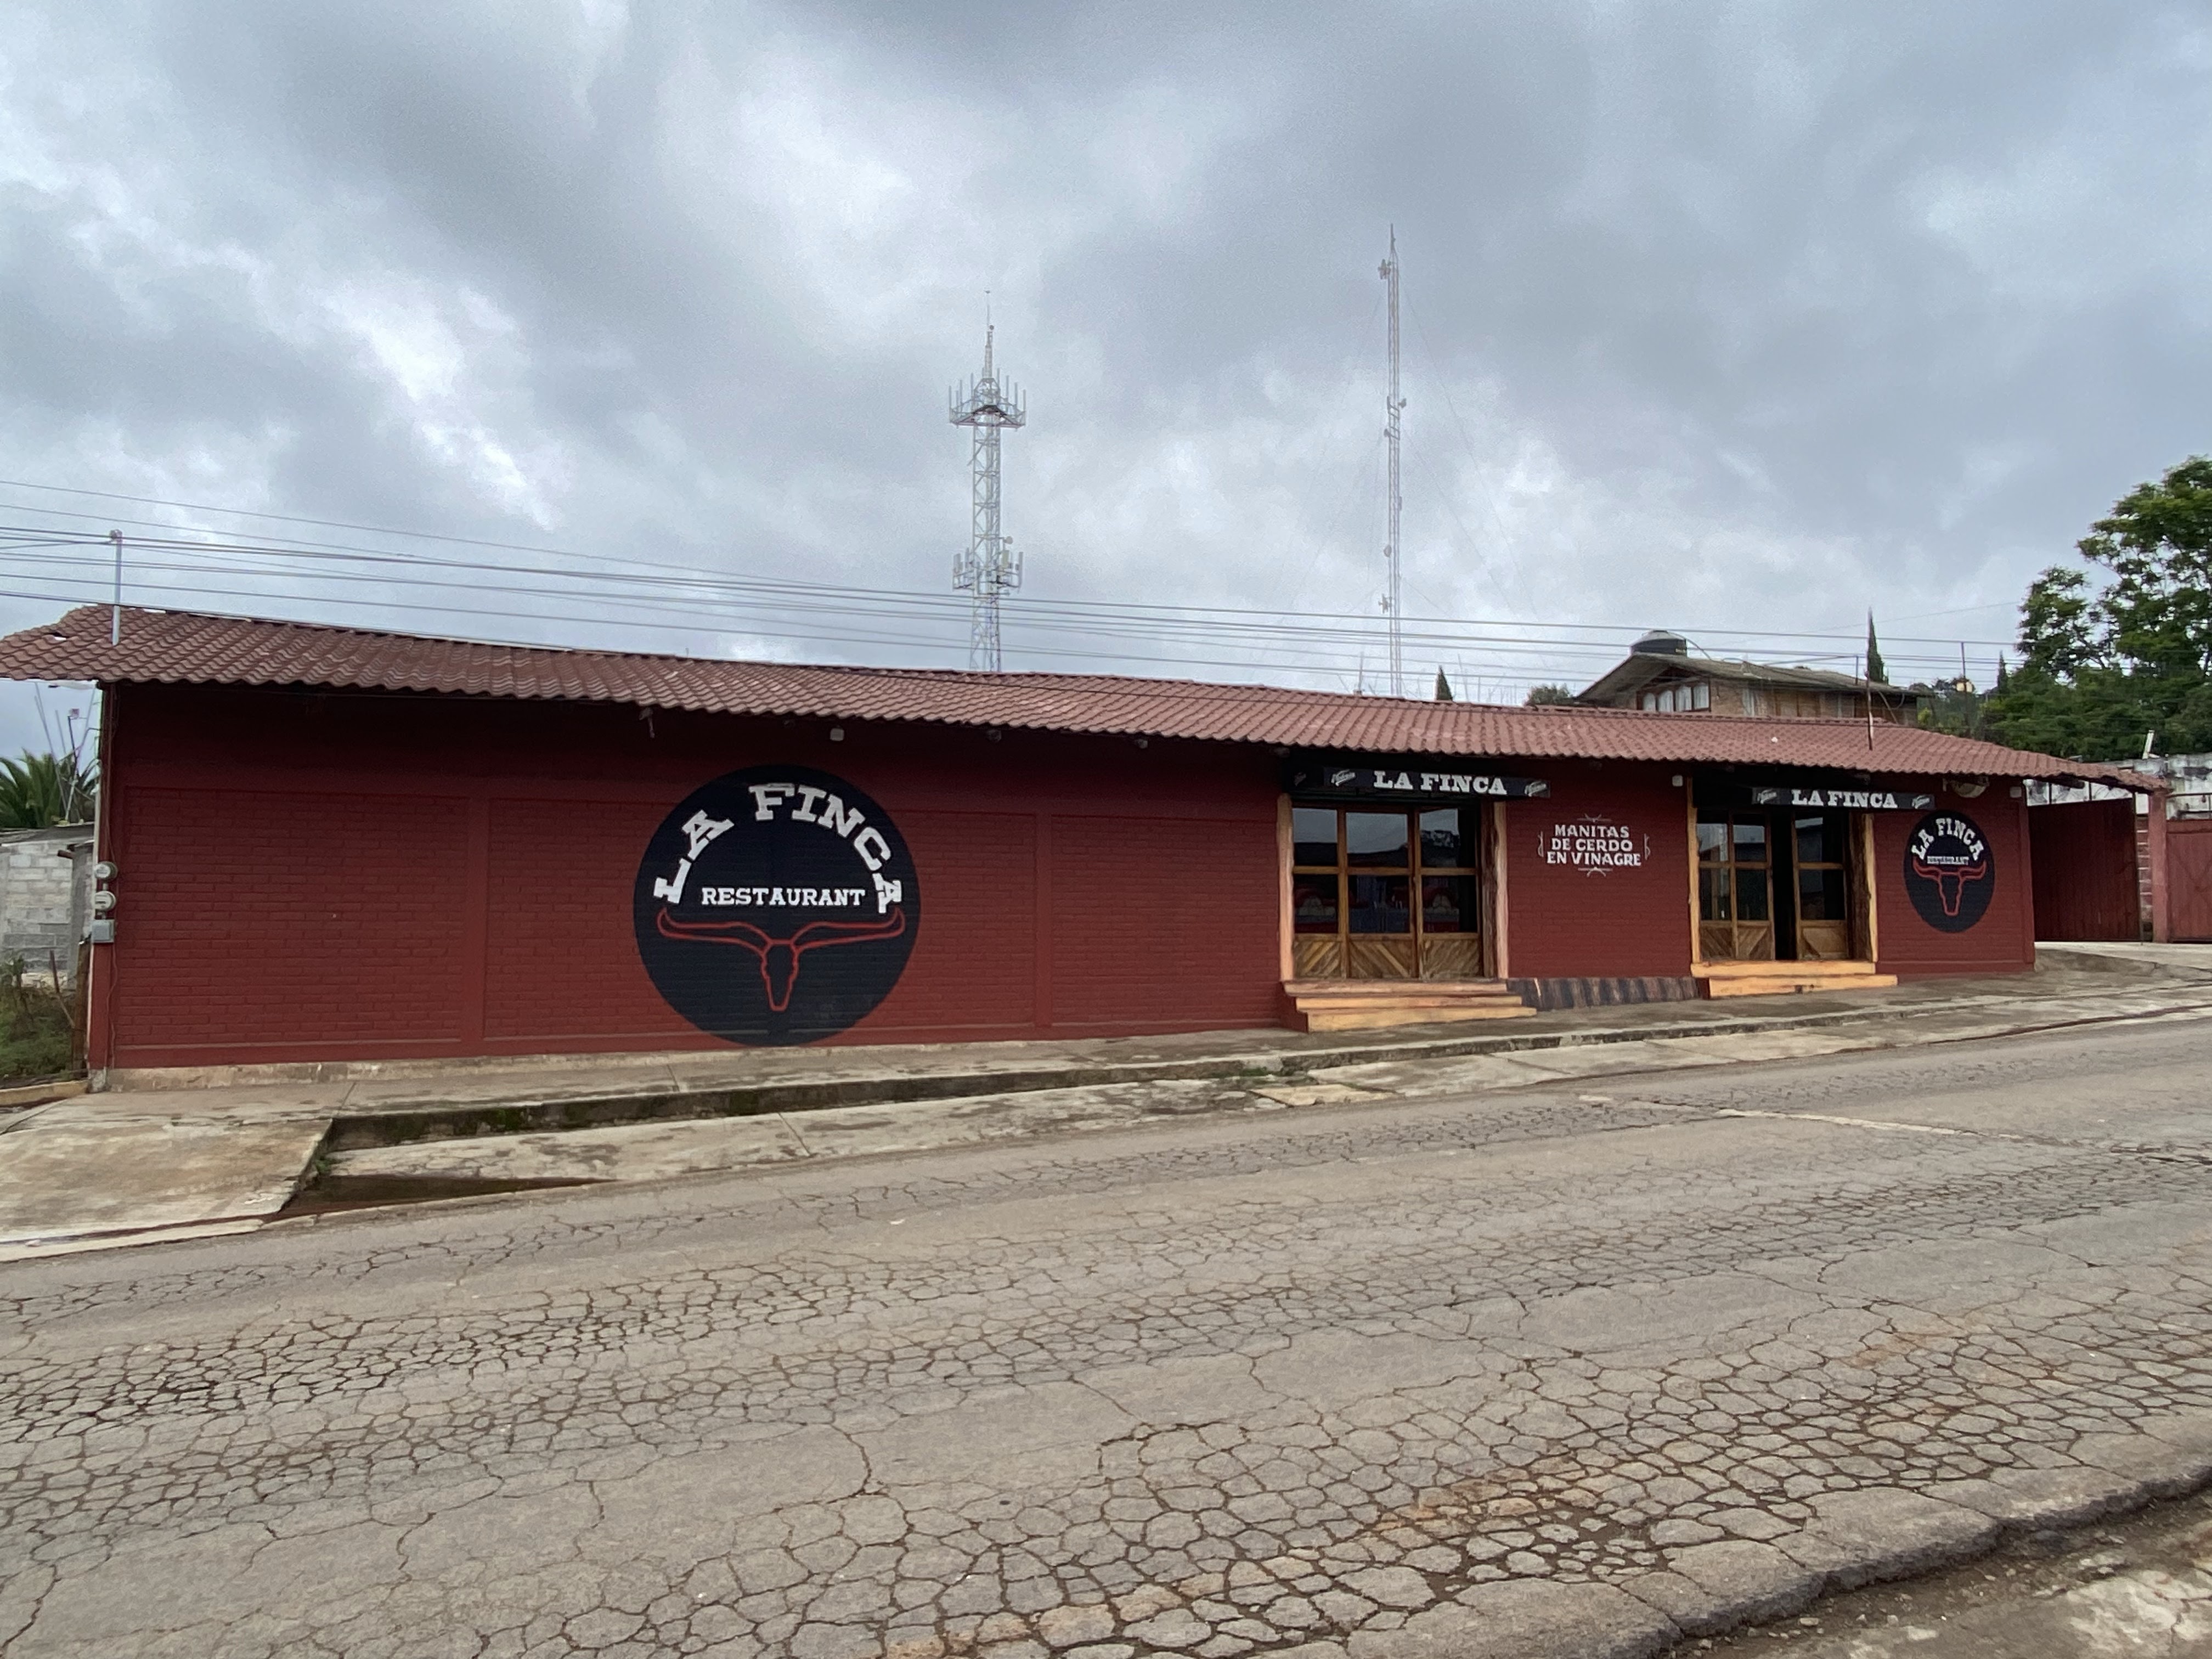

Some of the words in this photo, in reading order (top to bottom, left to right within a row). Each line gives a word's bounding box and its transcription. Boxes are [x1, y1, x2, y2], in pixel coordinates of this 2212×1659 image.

[1373, 770, 1413, 790] LA
[1420, 772, 1507, 795] FINCA
[1791, 789, 1824, 806] LA
[1827, 791, 1898, 809] FINCA
[1554, 824, 1629, 838] MANITAS
[1911, 828, 1934, 860] LA
[1936, 817, 1984, 861] FINCA
[653, 810, 735, 904] LA
[748, 783, 902, 913] FINCA
[1551, 838, 1571, 850] DE
[1575, 839, 1633, 851] CERDO
[1547, 851, 1567, 864] EN
[1571, 852, 1642, 866] VINAGRE
[702, 887, 865, 906] RESTAURANT
